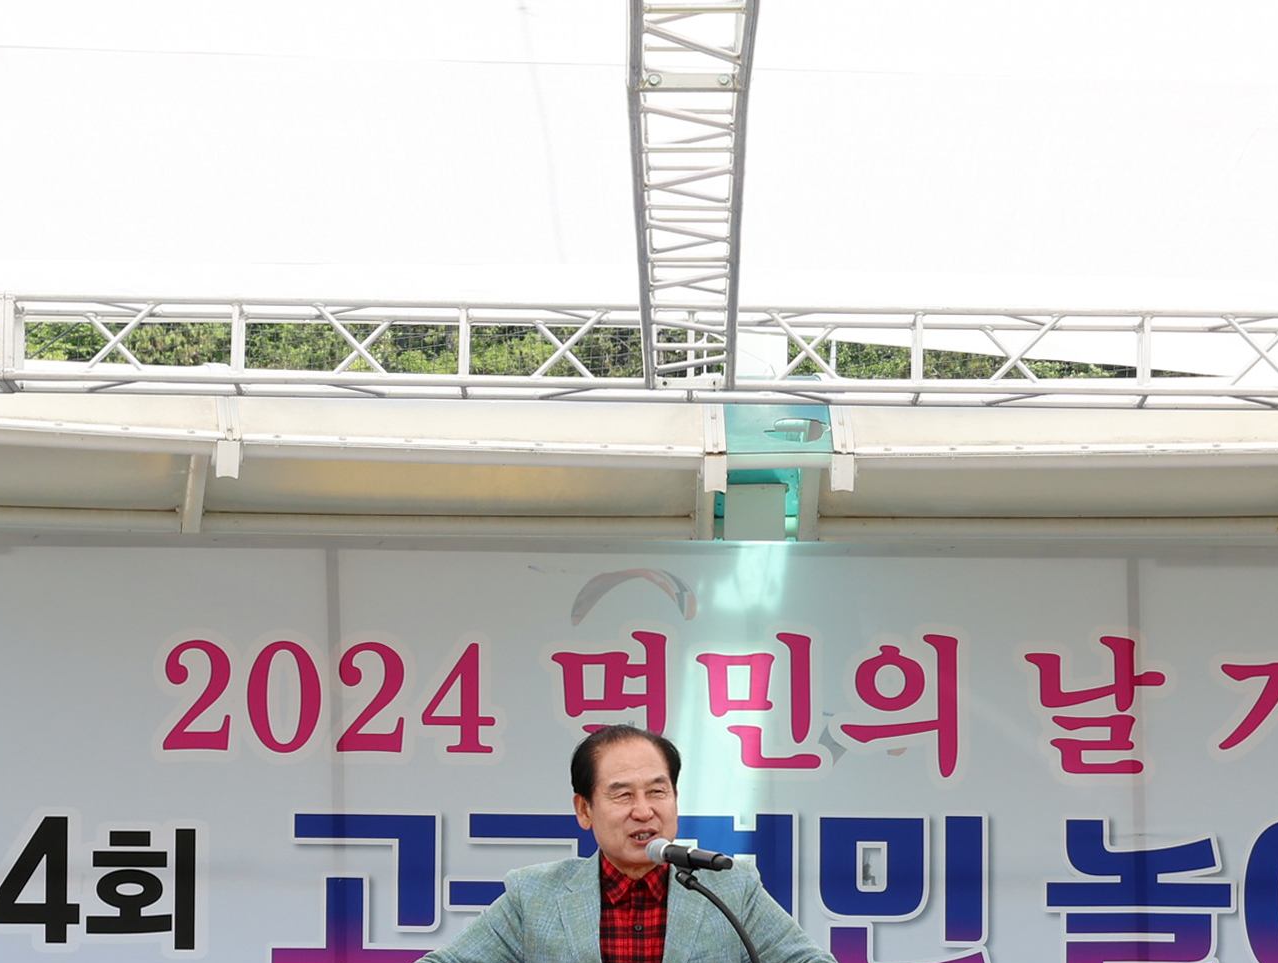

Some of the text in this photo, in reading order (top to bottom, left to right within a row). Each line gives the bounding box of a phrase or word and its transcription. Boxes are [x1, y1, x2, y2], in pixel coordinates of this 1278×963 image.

[161, 638, 496, 754] 2024
[551, 630, 959, 778] 면민의
[1023, 635, 1167, 777] 날
